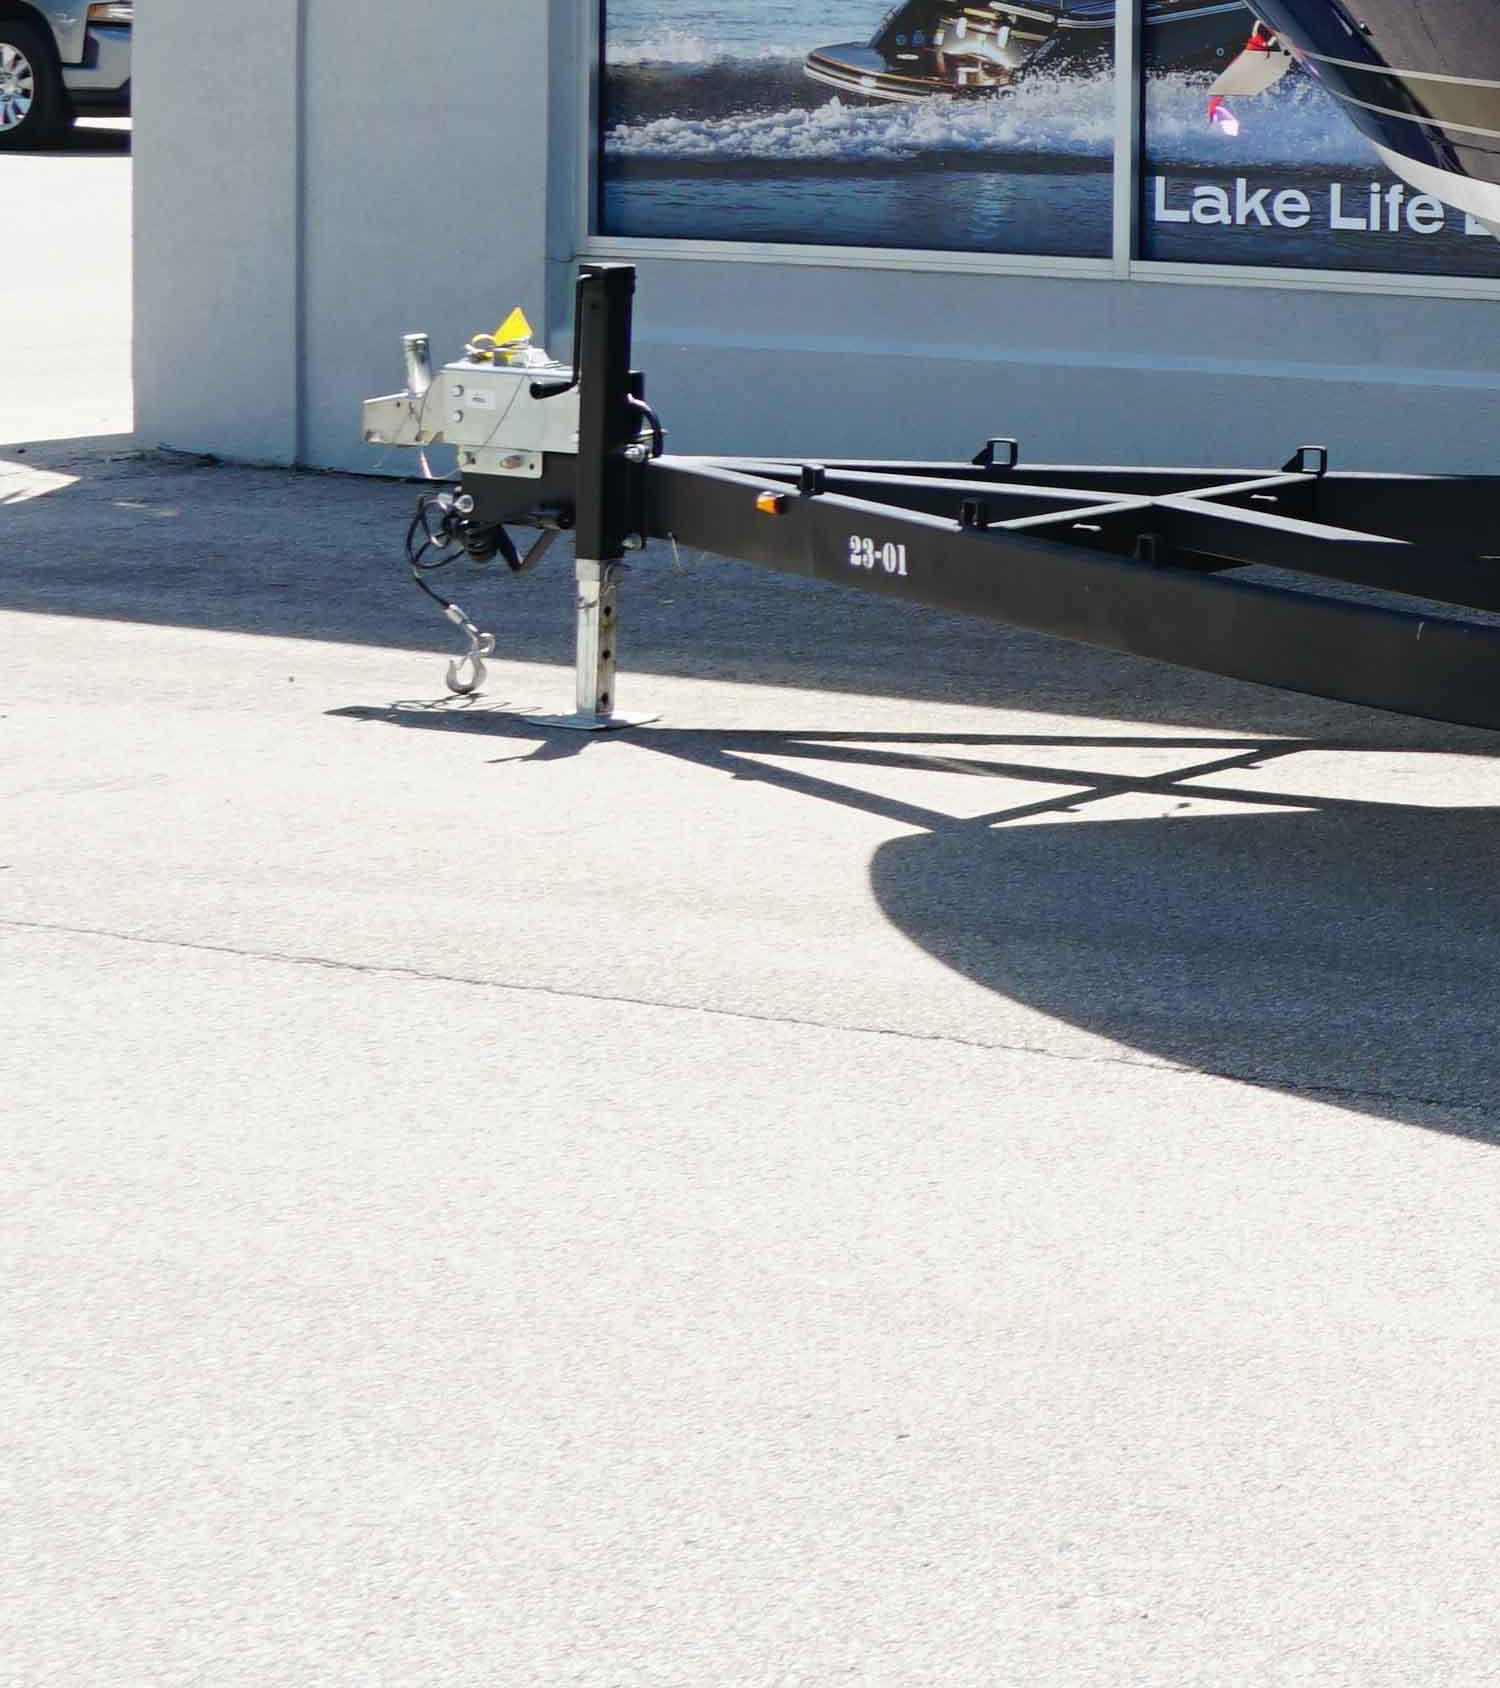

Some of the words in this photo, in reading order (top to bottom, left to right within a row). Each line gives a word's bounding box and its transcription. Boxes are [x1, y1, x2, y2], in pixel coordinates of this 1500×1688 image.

[1153, 174, 1312, 229] Lake
[1329, 181, 1445, 235] Life
[849, 534, 909, 577] 23-01
